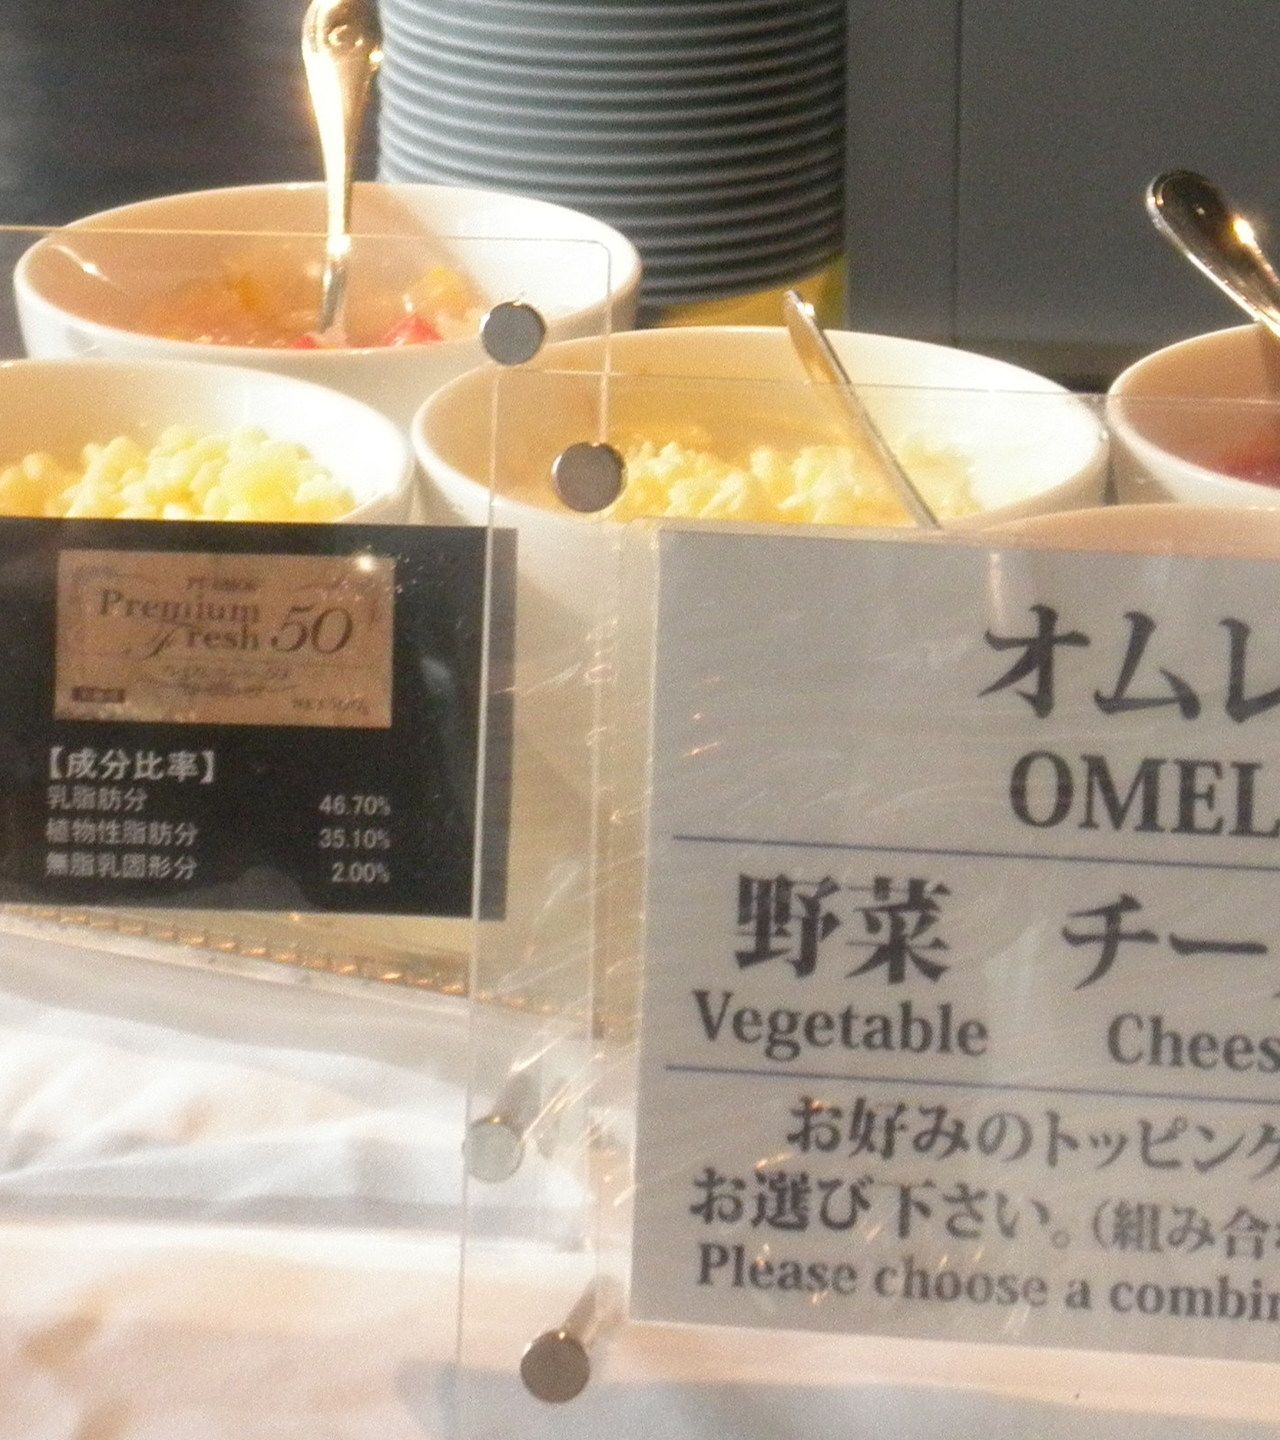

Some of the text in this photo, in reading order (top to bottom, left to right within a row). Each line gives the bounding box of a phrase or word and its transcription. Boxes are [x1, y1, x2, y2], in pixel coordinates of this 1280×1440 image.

[270, 603, 353, 654] 50
[48, 746, 215, 784] 【成分比率】
[319, 828, 391, 851] 35.10%
[331, 861, 391, 884] 2.00%
[733, 873, 951, 985] 野菜
[692, 989, 989, 1061] Vegetable
[696, 1242, 858, 1294] Please
[874, 1254, 1050, 1307] choose
[1063, 1277, 1092, 1310] a
